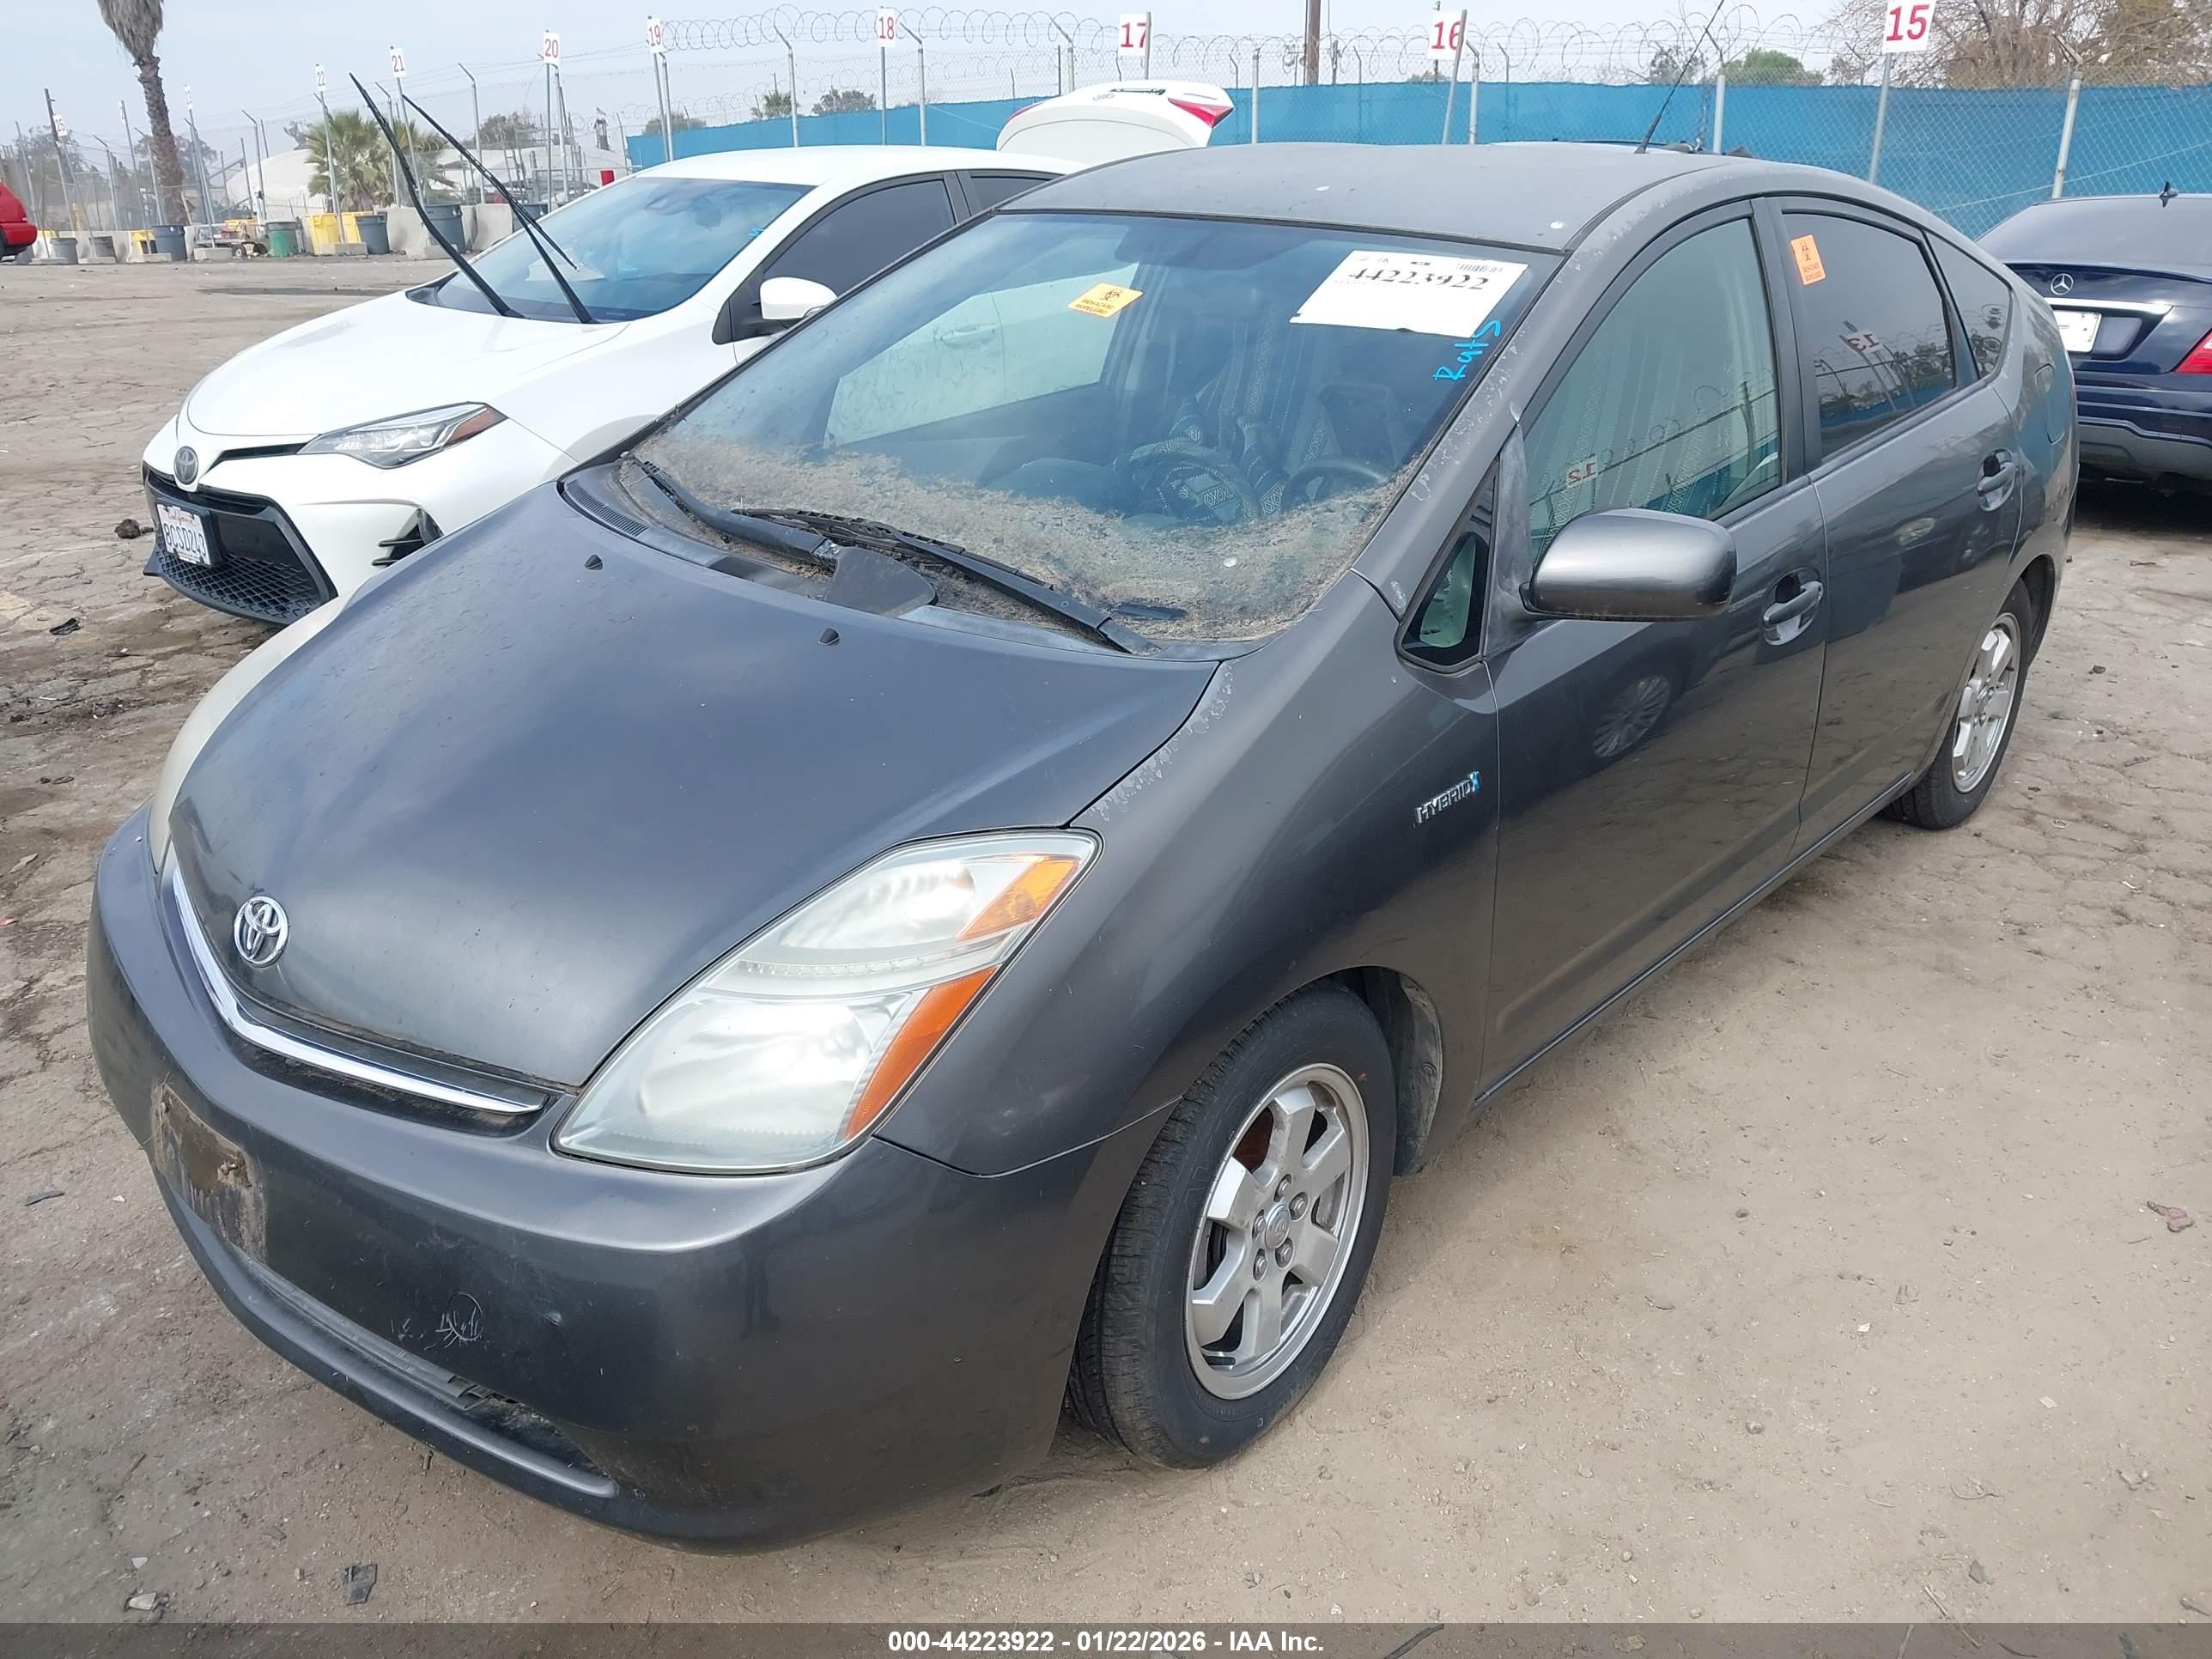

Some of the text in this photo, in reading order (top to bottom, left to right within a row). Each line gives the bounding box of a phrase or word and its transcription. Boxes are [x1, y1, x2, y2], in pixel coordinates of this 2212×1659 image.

[878, 16, 895, 40] 18
[1886, 3, 1931, 41] 15
[648, 24, 662, 46] 19
[1121, 21, 1147, 49] 17
[1431, 20, 1462, 51] 16
[544, 38, 559, 58] 20
[392, 54, 405, 72] 21
[1348, 267, 1489, 290] 44223922
[1414, 778, 1472, 823] HYBRID
